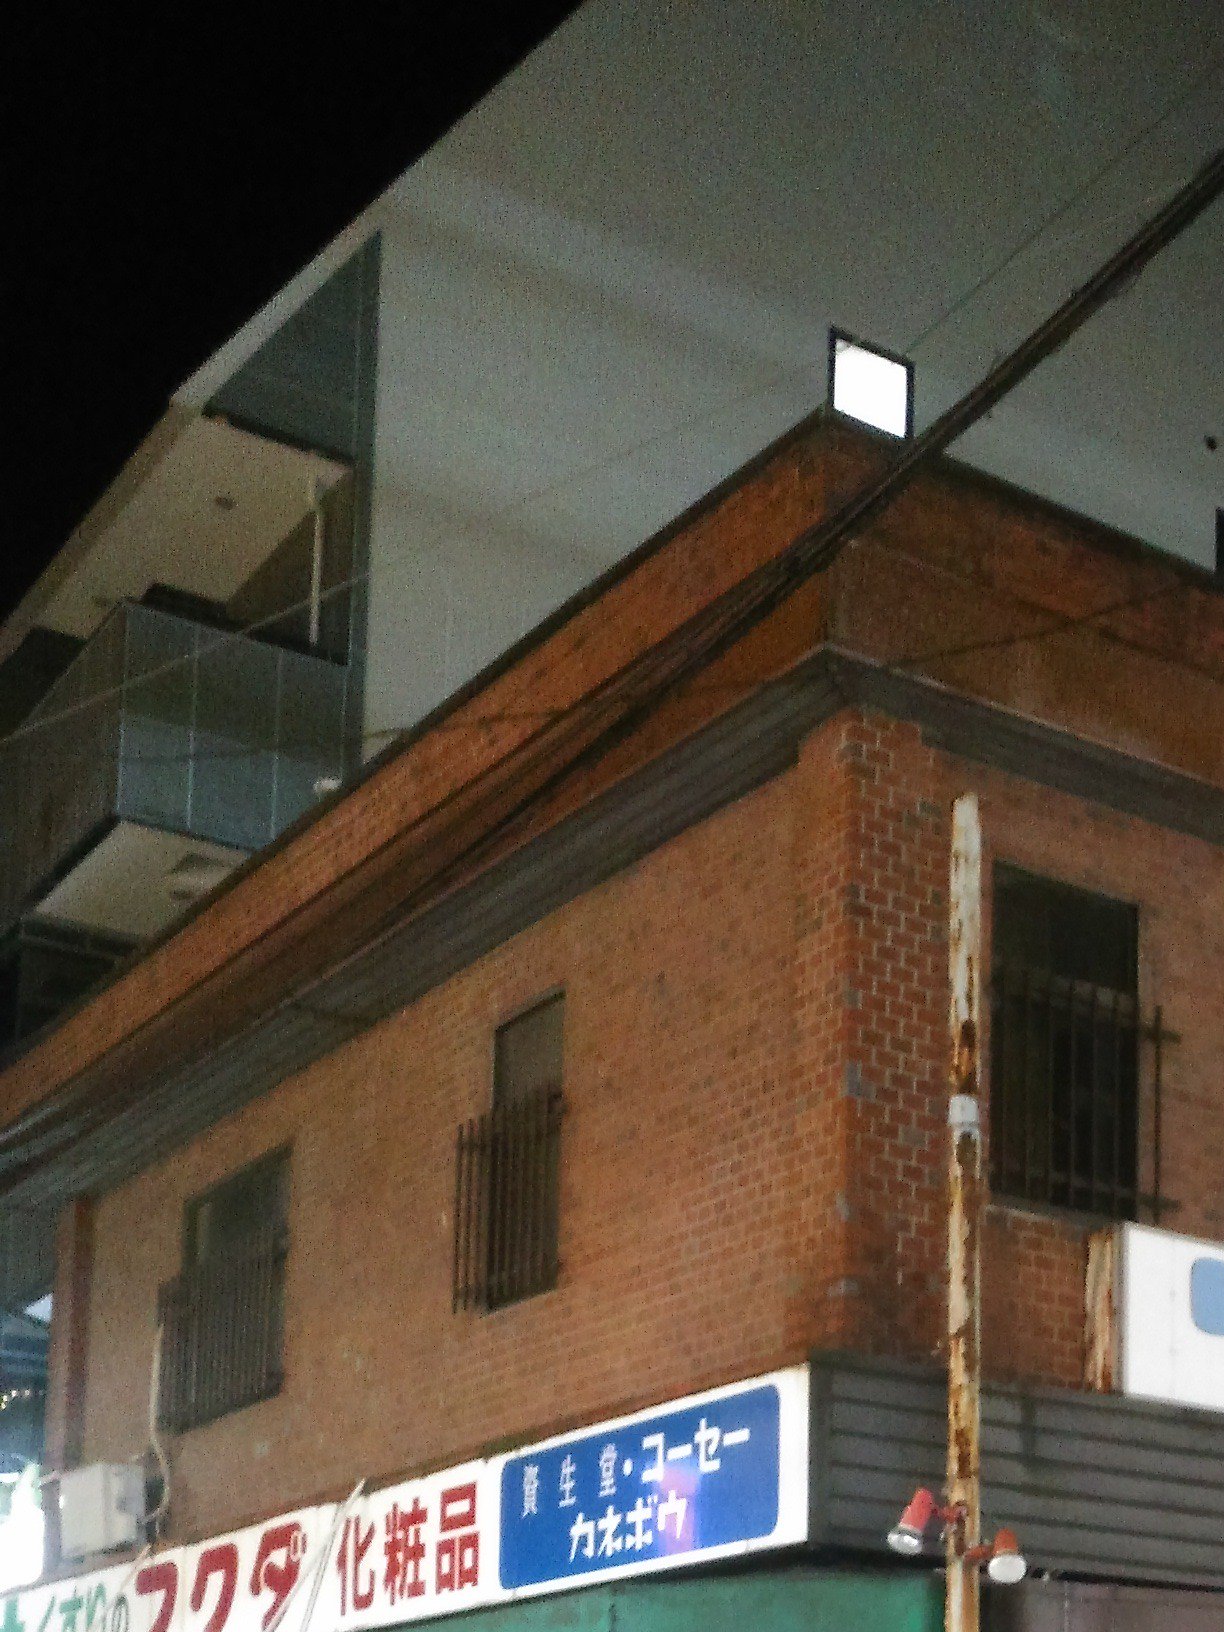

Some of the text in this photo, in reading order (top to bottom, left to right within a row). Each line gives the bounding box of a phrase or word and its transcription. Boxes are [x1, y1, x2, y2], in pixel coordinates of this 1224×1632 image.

[335, 1480, 480, 1617] 化粧品
[568, 1489, 688, 1564] カネボウ
